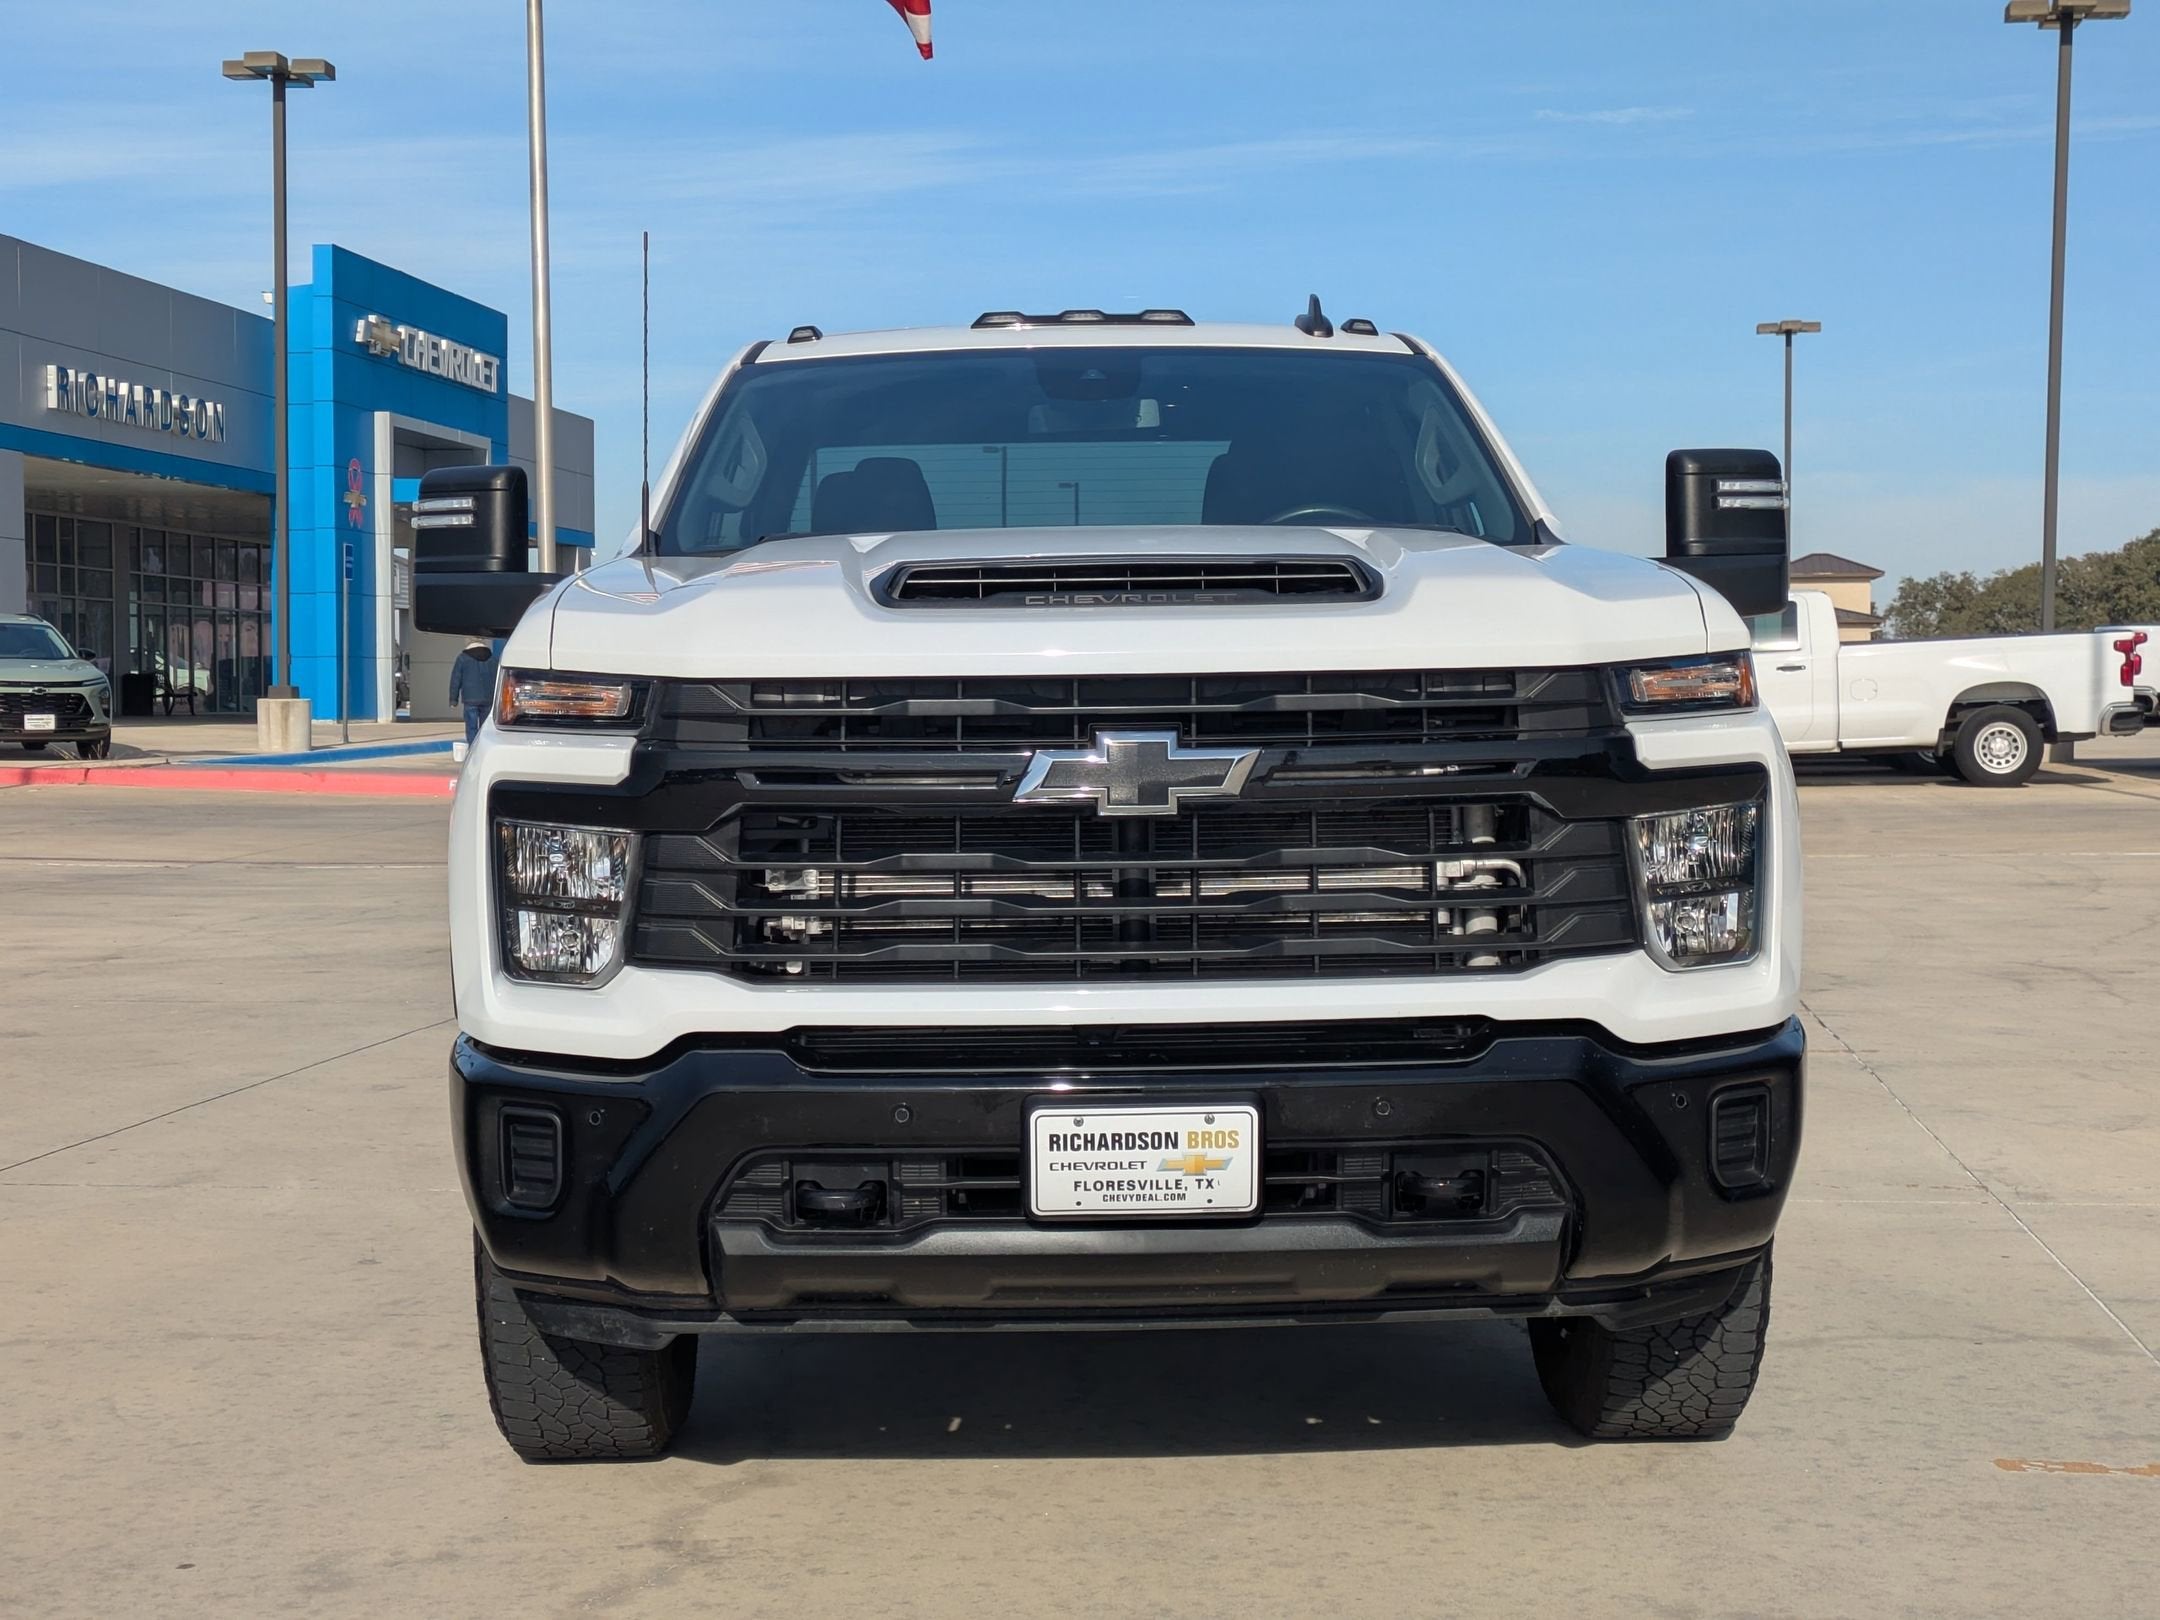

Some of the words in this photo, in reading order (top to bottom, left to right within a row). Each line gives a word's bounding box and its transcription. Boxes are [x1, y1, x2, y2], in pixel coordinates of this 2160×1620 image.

[397, 325, 499, 393] CHEVROLET
[46, 364, 226, 443] RICHARDSON
[1025, 593, 1238, 606] CHEVROLET
[1049, 1131, 1179, 1152] RICHARDSON
[1187, 1130, 1240, 1149] BROS
[1049, 1160, 1148, 1172] CHEVROLET
[1073, 1179, 1189, 1192] FLORESVILLE,
[1195, 1178, 1215, 1190] TX
[1102, 1192, 1187, 1203] CHEVYDEAL.COM
